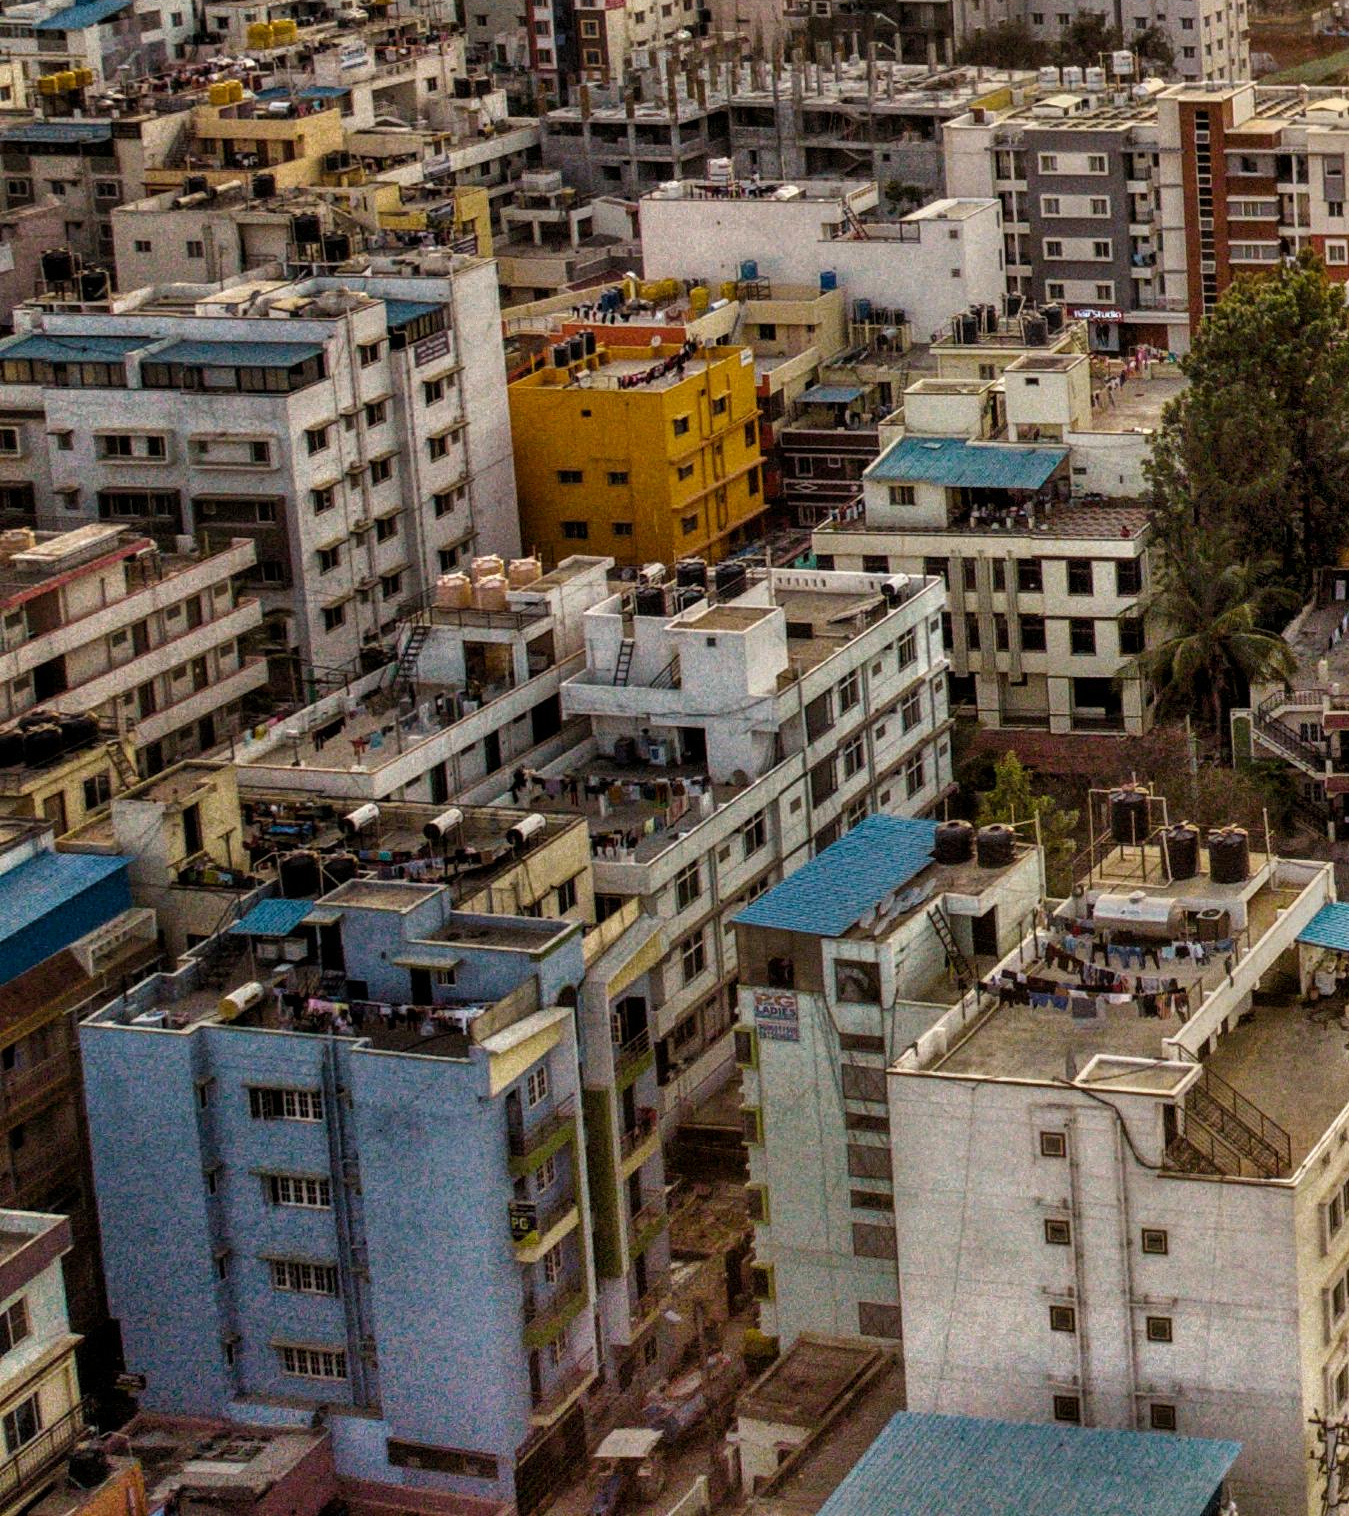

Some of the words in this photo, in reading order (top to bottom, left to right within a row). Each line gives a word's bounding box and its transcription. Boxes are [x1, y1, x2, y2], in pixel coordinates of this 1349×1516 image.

[1093, 309, 1122, 319] Studio
[756, 994, 795, 1007] PG
[511, 1216, 529, 1230] PG
